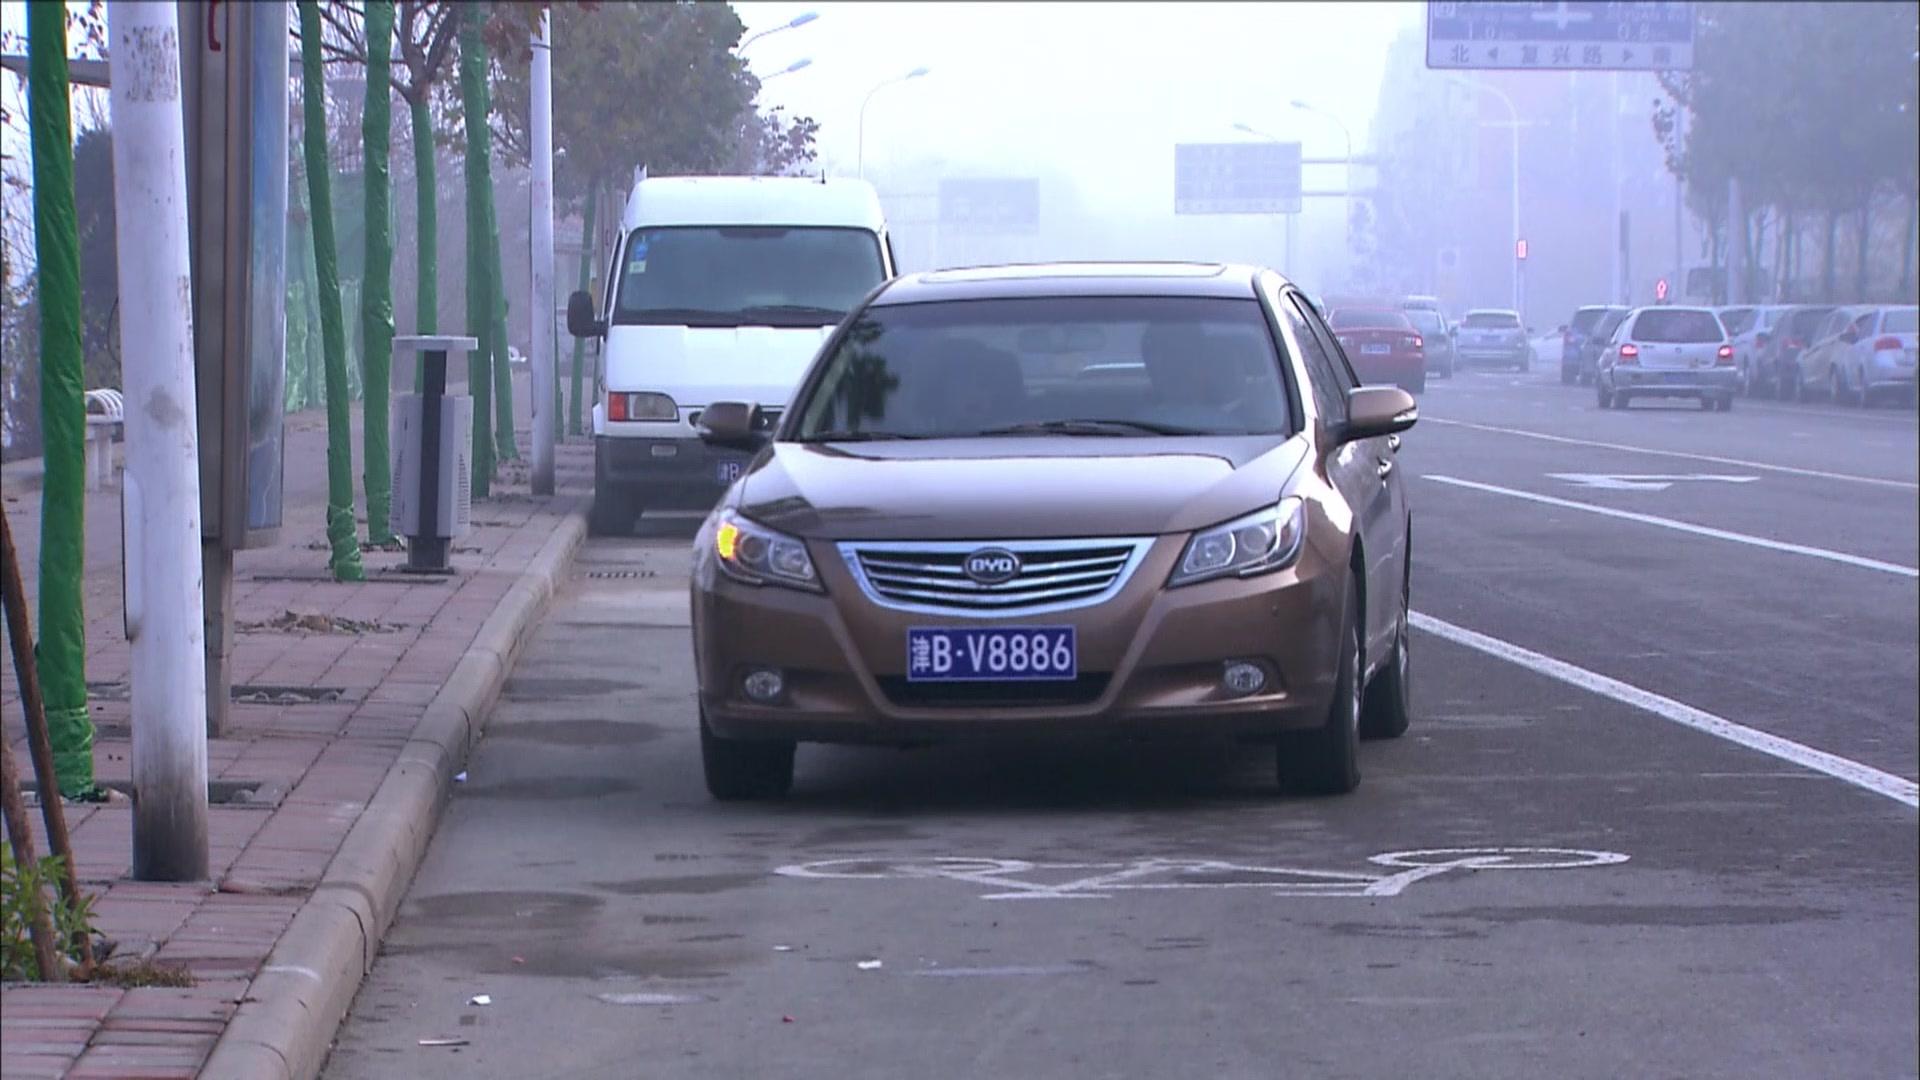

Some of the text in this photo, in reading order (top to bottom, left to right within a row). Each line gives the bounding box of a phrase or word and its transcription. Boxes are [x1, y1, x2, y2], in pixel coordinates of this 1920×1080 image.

[1450, 44, 1470, 63] 北
[1520, 45, 1602, 64] 复兴路
[971, 558, 1013, 572] BYD
